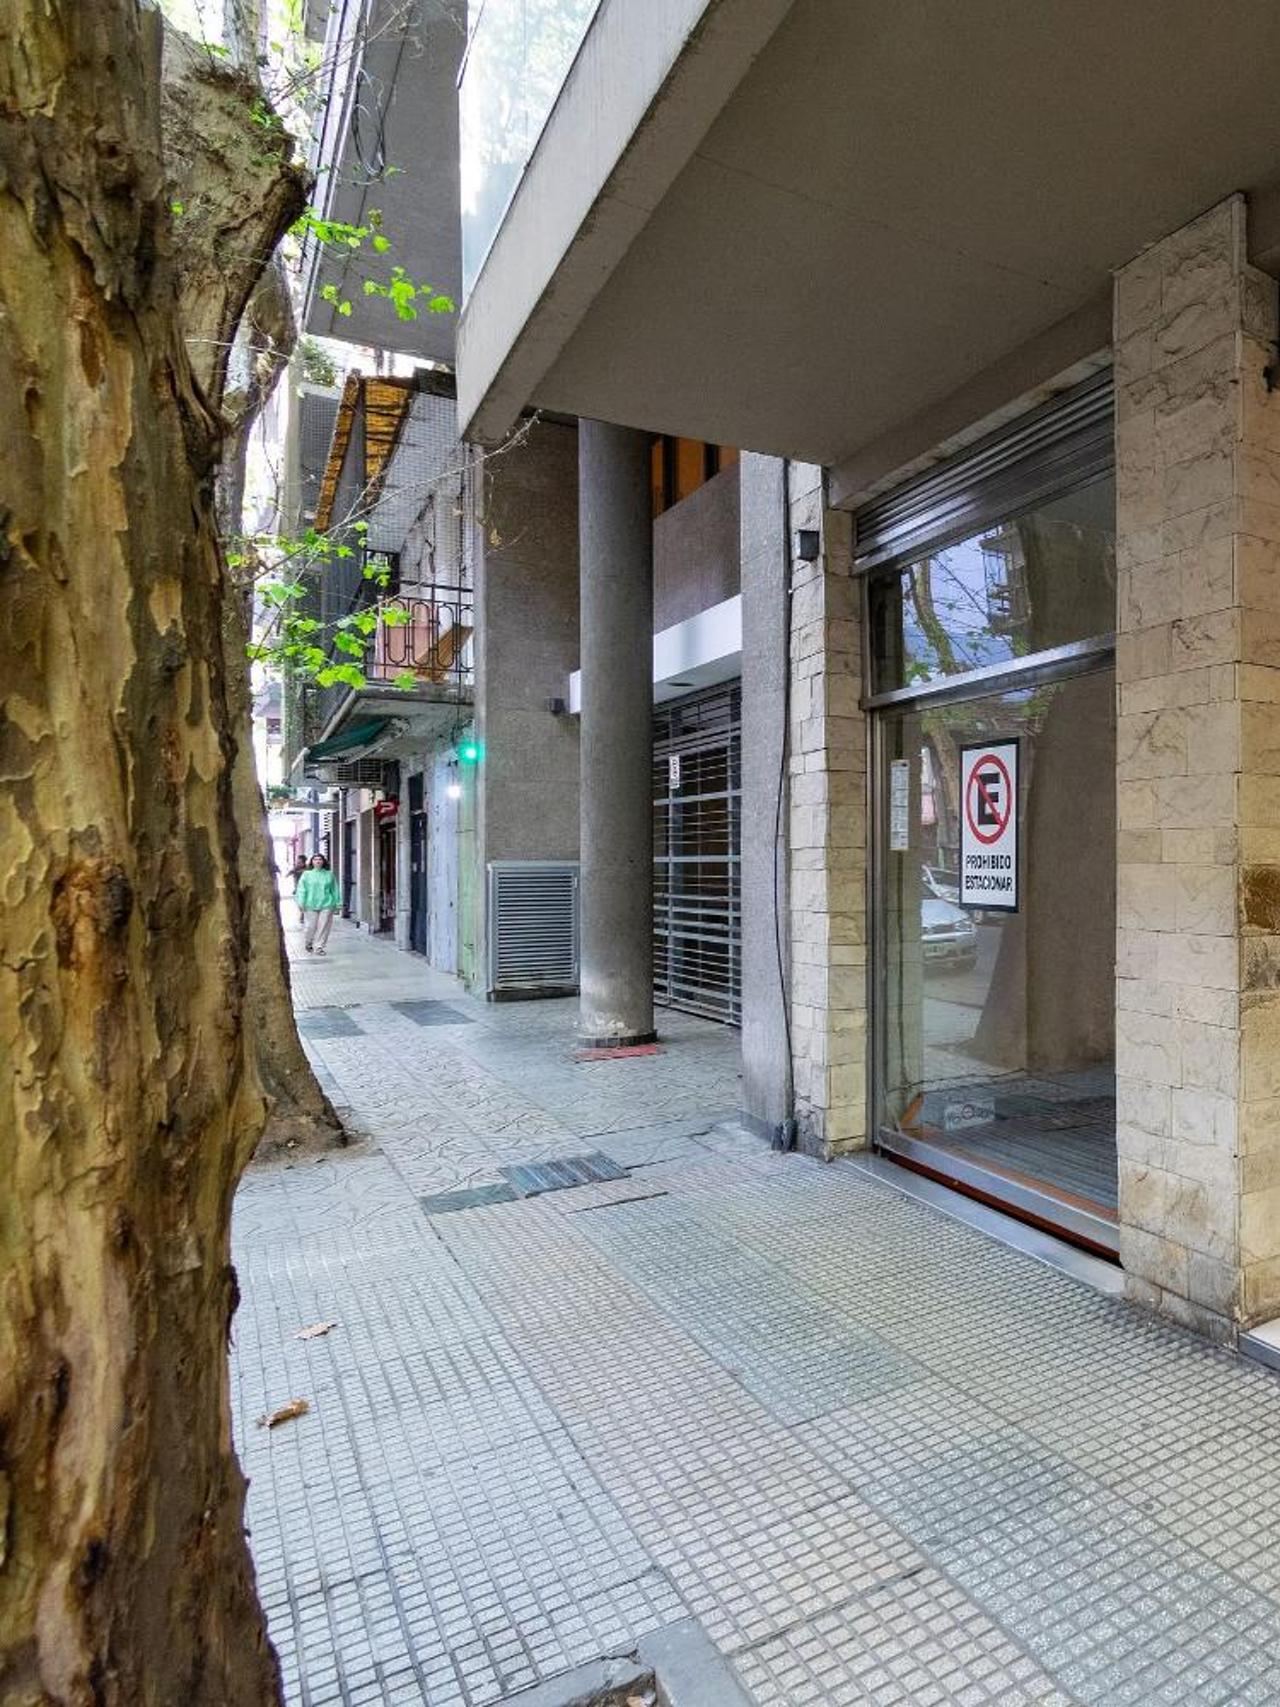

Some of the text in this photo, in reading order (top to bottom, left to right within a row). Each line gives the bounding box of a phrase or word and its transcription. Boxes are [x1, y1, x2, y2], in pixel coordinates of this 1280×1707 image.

[977, 772, 1002, 826] E
[965, 854, 1012, 870] PROHIBIDO
[965, 875, 1014, 892] ESTACIONAR
